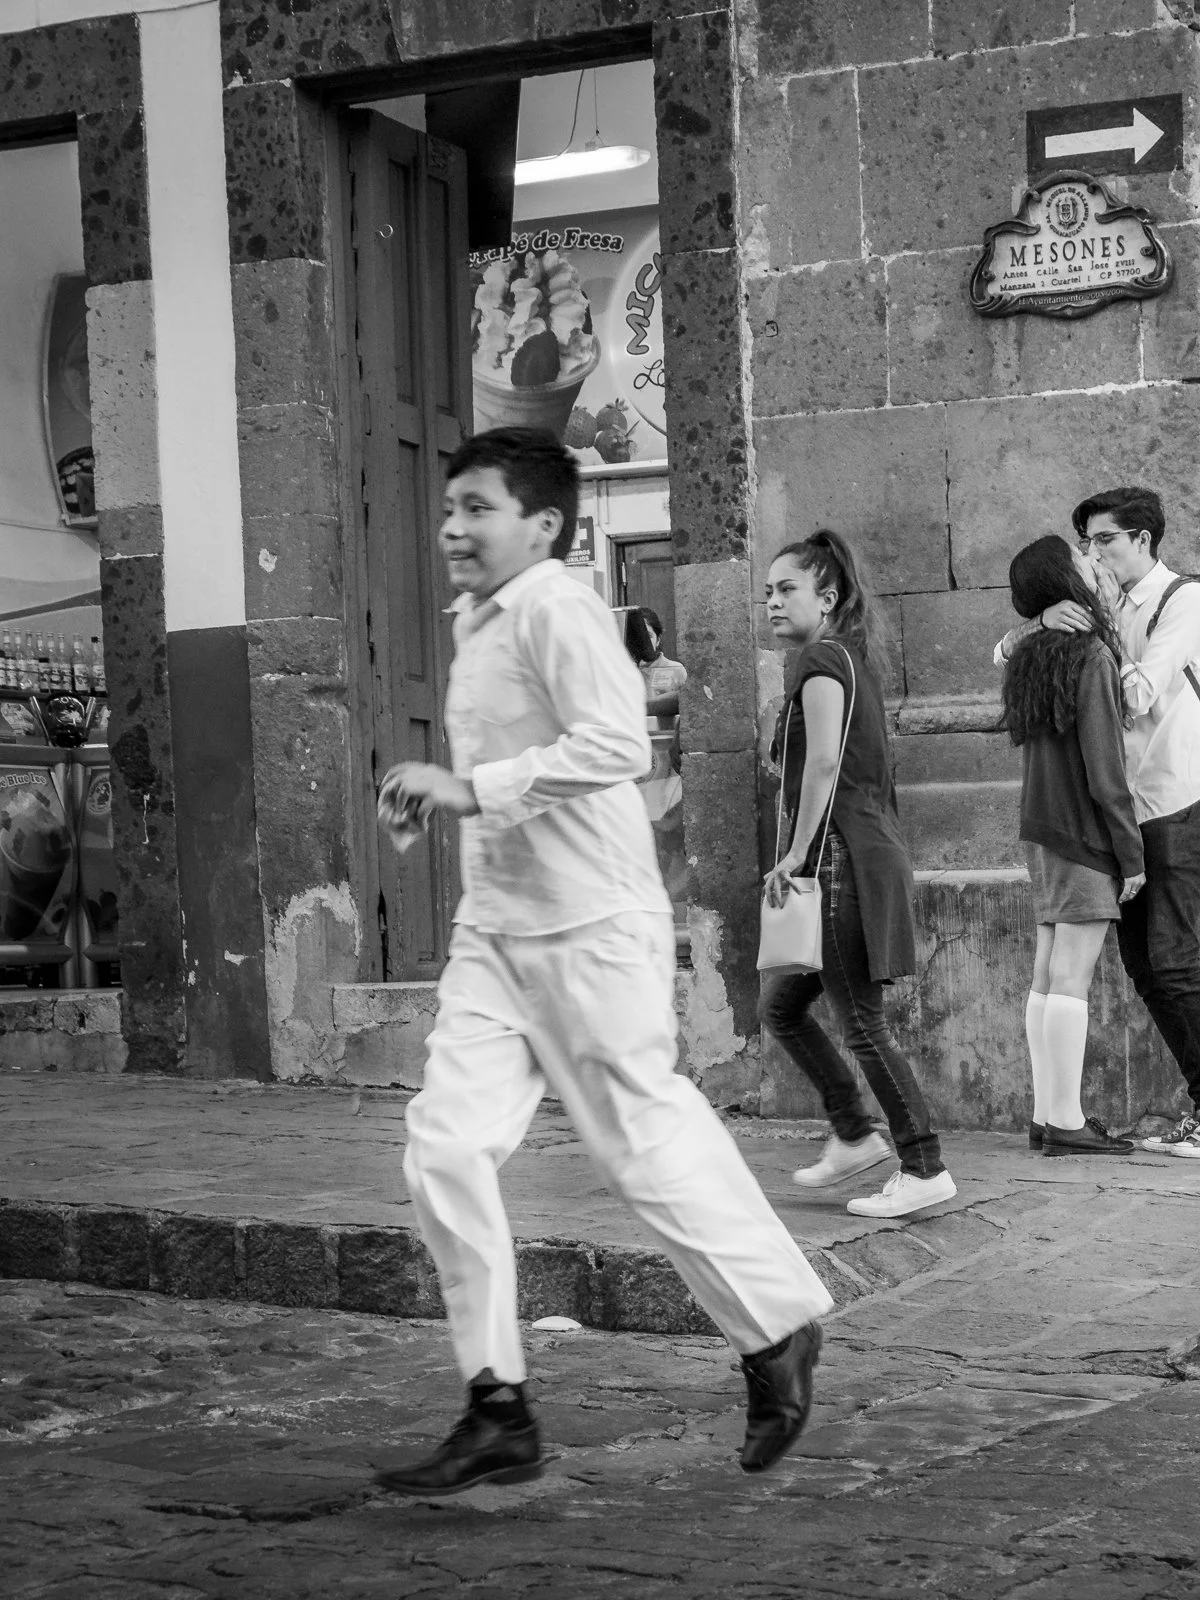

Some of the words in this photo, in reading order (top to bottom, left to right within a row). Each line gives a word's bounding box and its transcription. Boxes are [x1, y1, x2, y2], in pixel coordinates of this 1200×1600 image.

[469, 232, 529, 269] rapé
[532, 229, 561, 251] de
[561, 227, 624, 252] Fresa
[1009, 234, 1126, 268] MESONES
[1003, 271, 1028, 280] Antes
[1068, 264, 1083, 274] San
[1090, 258, 1109, 270] José
[1000, 281, 1036, 292] Manzana
[1051, 276, 1081, 287] Cuartel
[1100, 271, 1112, 280] CP
[625, 252, 662, 356] MIC
[1028, 294, 1084, 306] Ayuntamiento
[565, 555, 590, 563] UXILIOS
[6, 774, 30, 787] Blue
[29, 771, 47, 785] Ice
